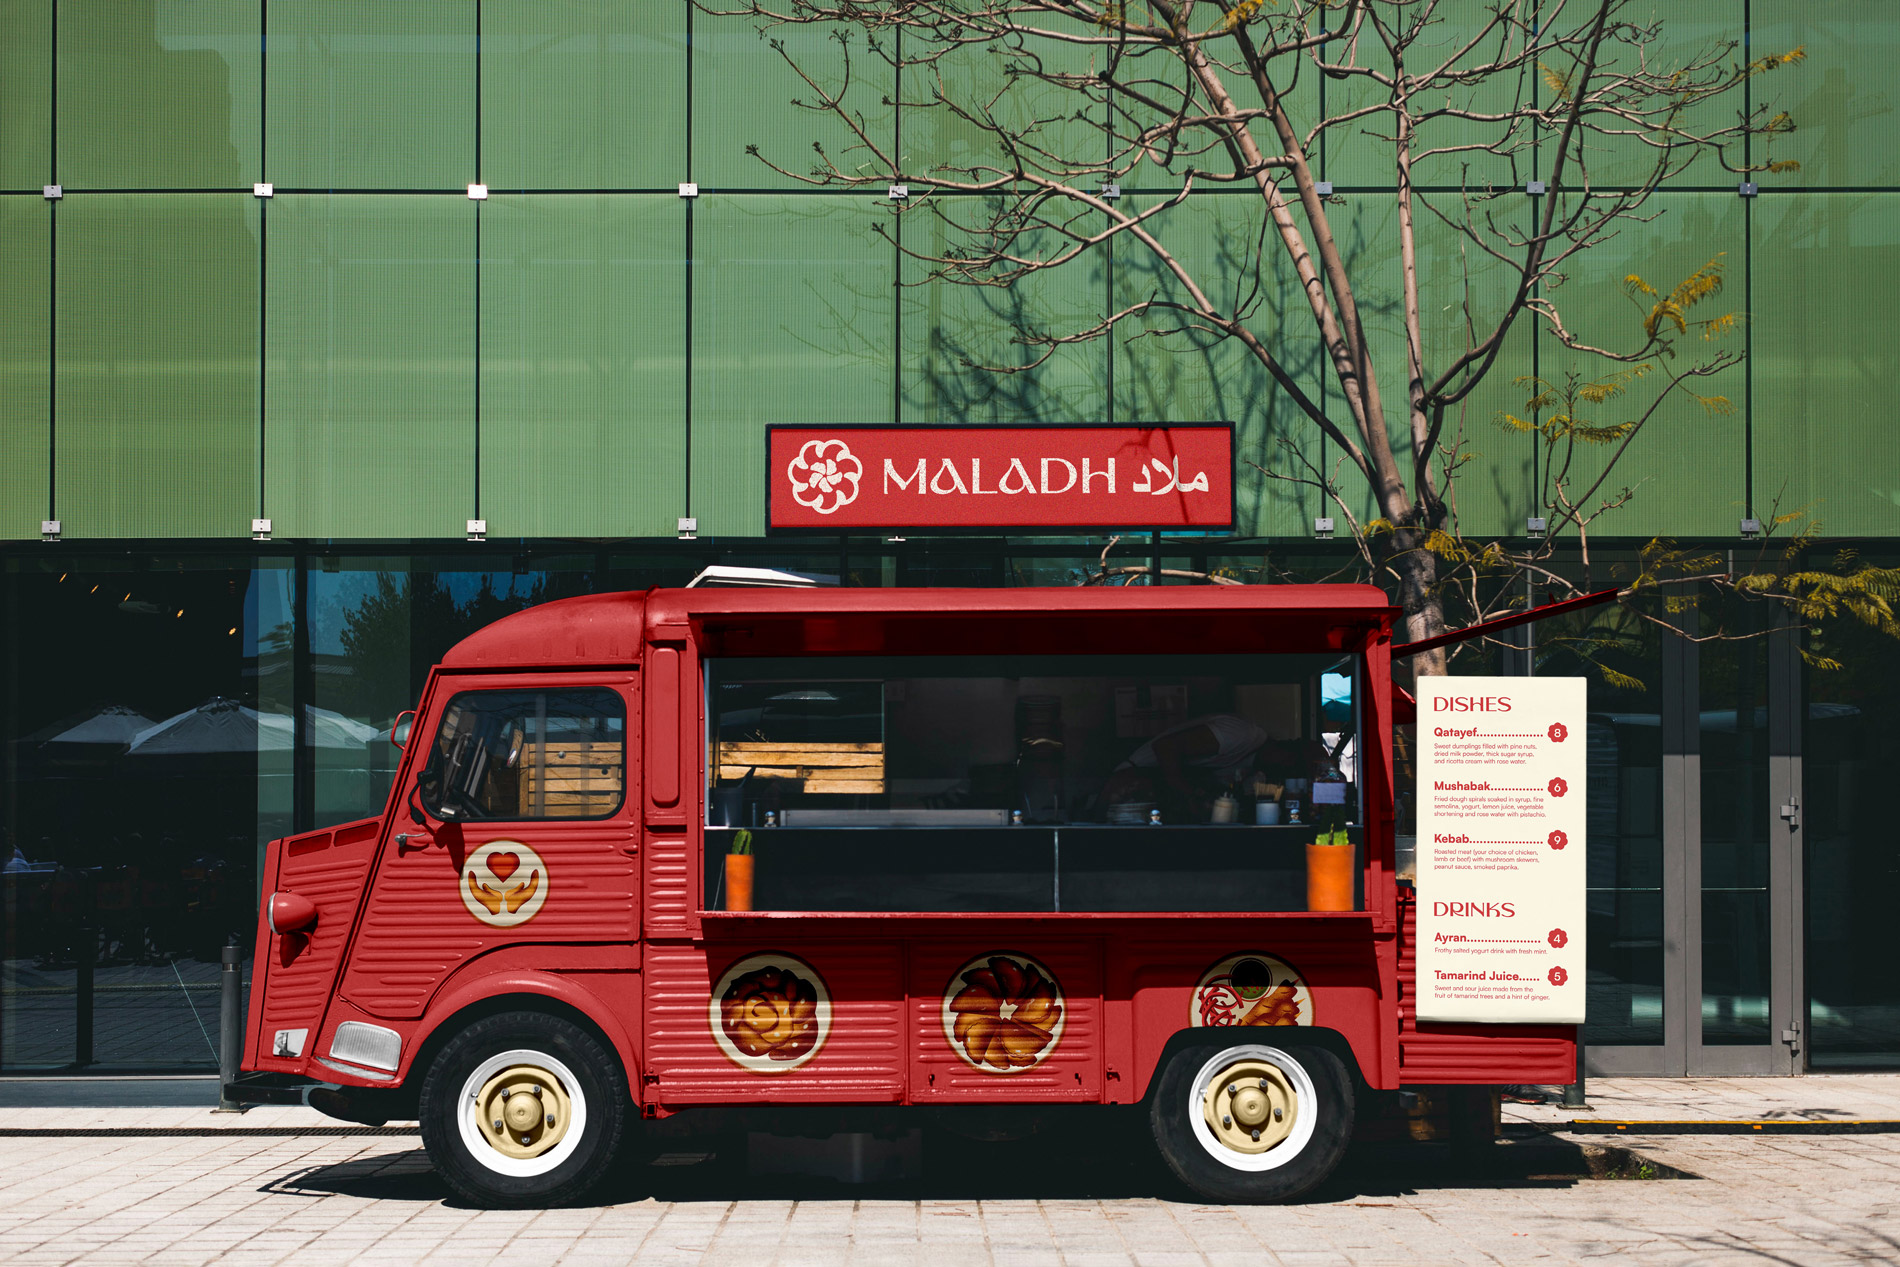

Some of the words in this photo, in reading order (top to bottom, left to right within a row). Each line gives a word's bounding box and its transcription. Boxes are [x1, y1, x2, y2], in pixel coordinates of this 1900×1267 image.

[884, 458, 1116, 494] MALADH
[1133, 455, 1208, 495] ملاد
[1434, 697, 1511, 712] DISHES
[1554, 729, 1561, 738] 8
[1452, 743, 1481, 751] dumplings
[1510, 743, 1522, 751] pine
[1554, 783, 1561, 793] 6
[1468, 796, 1486, 804] spirals
[1517, 803, 1544, 811] vegetable
[1434, 810, 1463, 818] shortening
[1554, 835, 1561, 845] 9
[1457, 856, 1471, 864] beef)
[1434, 902, 1515, 917] DRINKS
[1553, 934, 1561, 943] 4
[1434, 947, 1452, 955] Frothy
[1434, 970, 1486, 980] Tamarind
[1554, 972, 1561, 981] 5
[1478, 985, 1491, 993] juice
